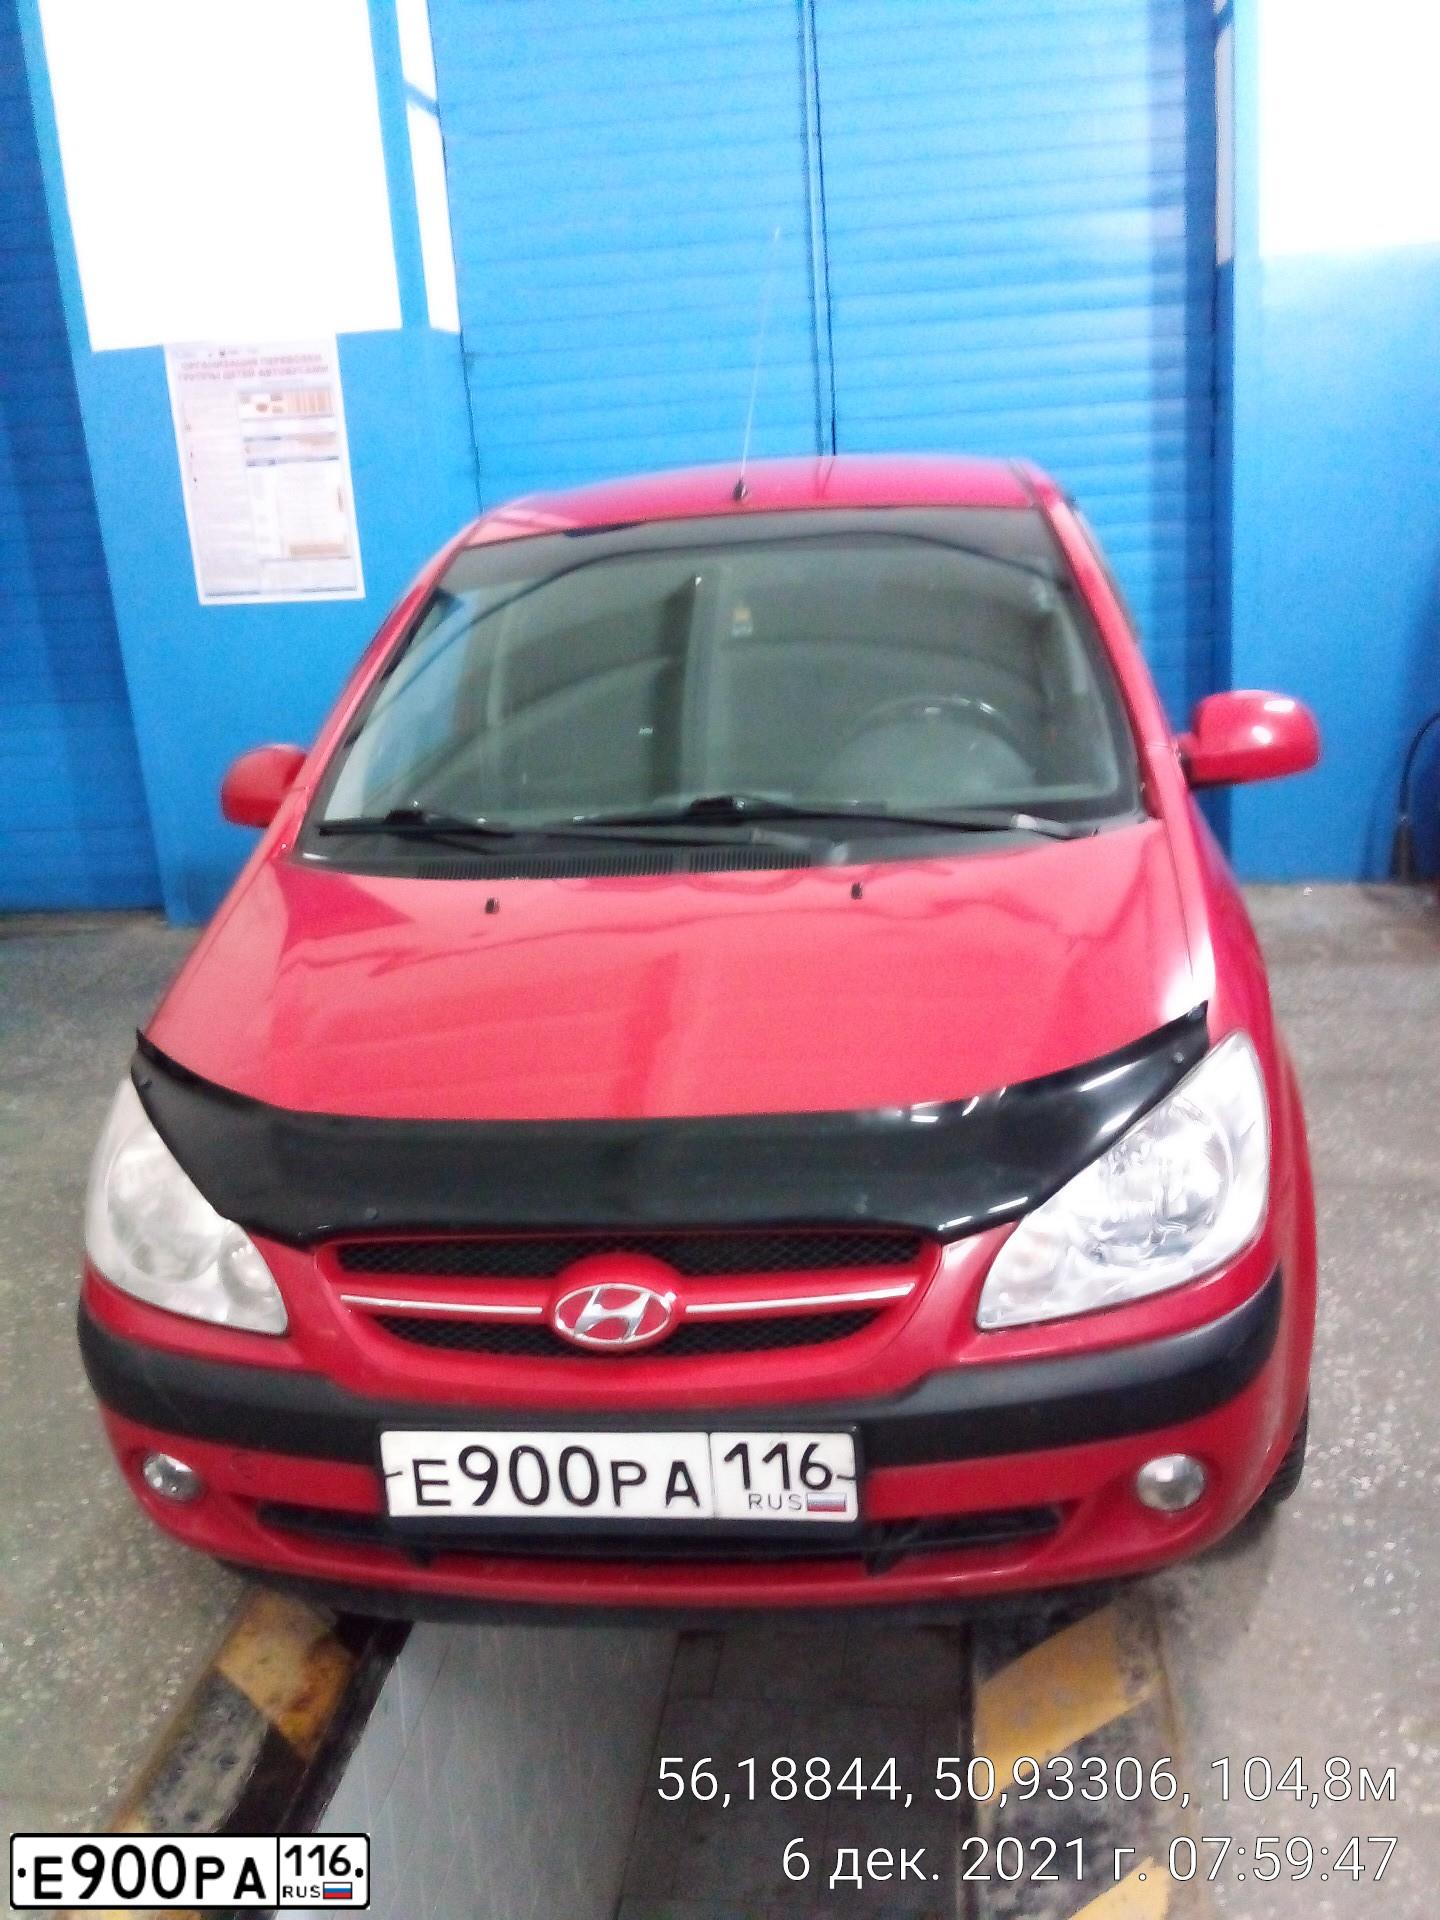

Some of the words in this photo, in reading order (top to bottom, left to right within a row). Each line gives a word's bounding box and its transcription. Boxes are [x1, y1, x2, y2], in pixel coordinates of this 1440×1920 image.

[411, 1444, 701, 1508] Е900РА
[723, 1441, 833, 1491] 116
[748, 1493, 802, 1511] RUS
